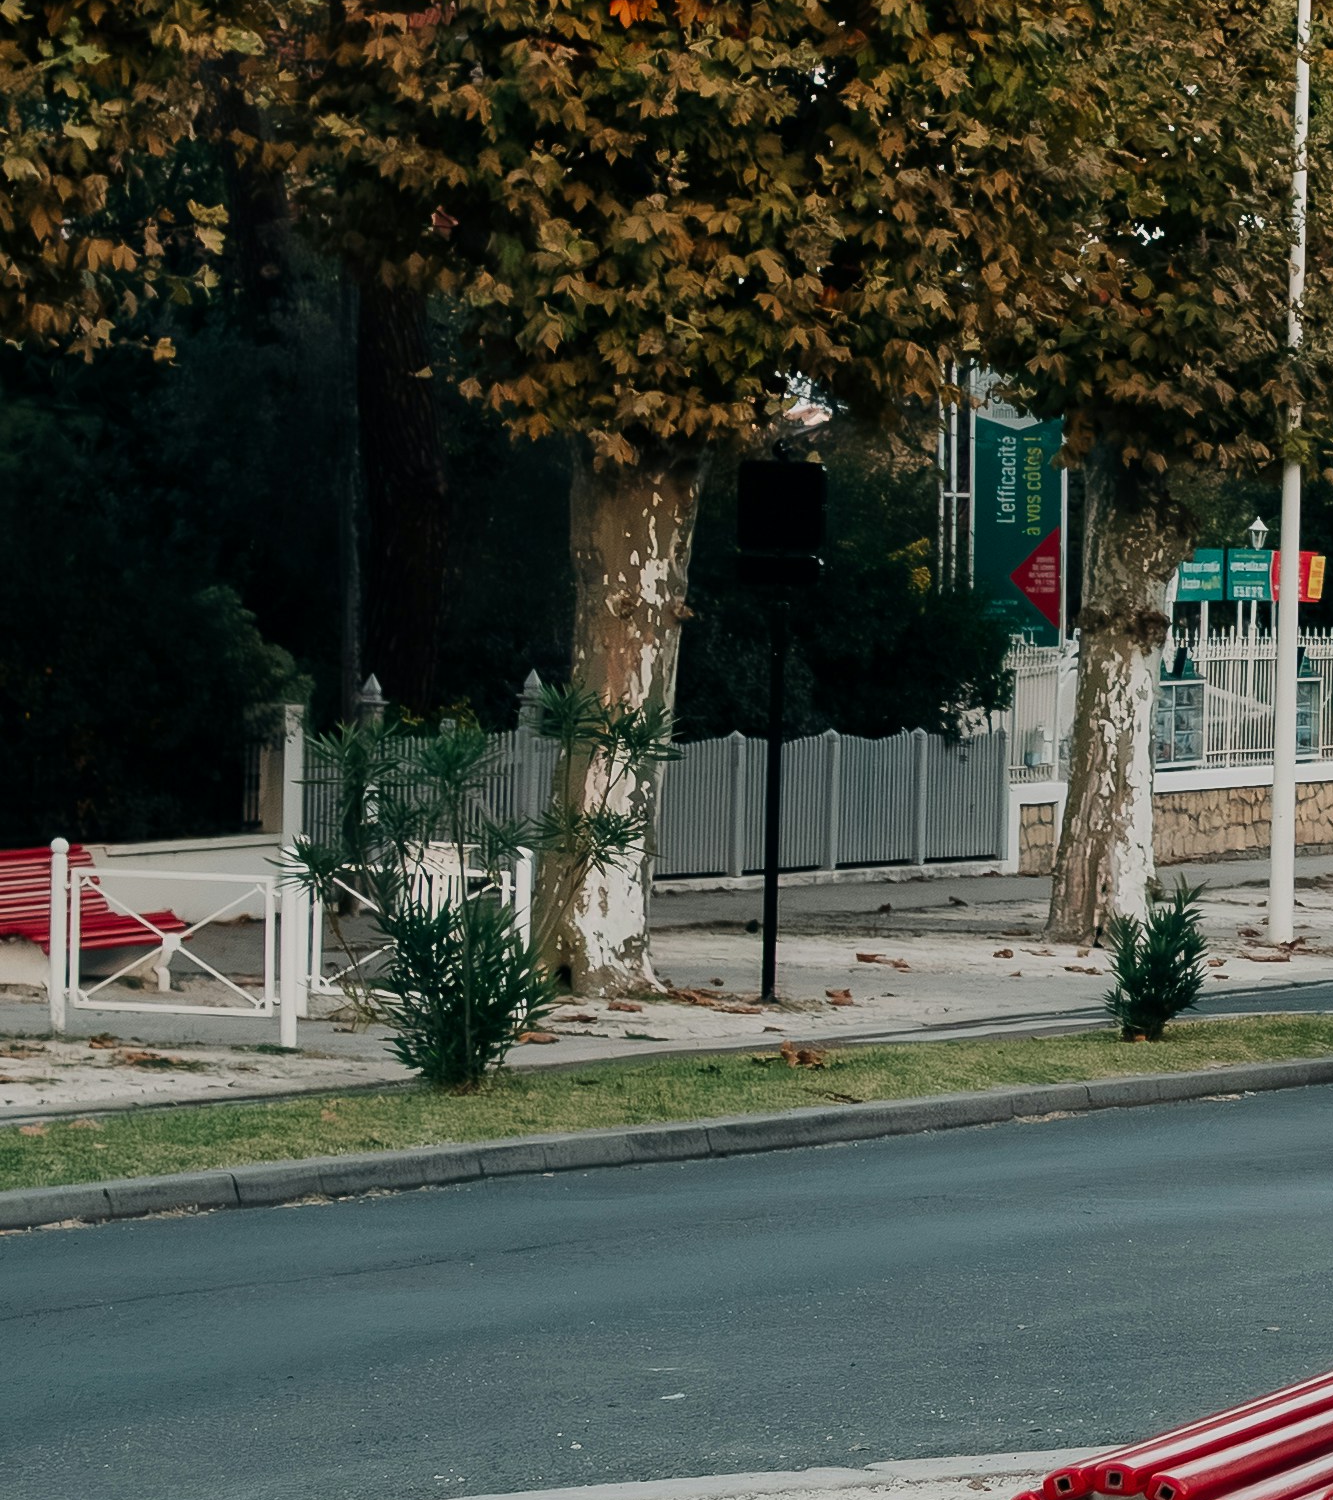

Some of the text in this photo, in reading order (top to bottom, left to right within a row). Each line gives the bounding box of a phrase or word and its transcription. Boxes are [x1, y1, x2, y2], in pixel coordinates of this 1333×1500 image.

[996, 435, 1017, 523] L'efficacité
[1026, 494, 1042, 523] vos
[1022, 527, 1042, 536] à
